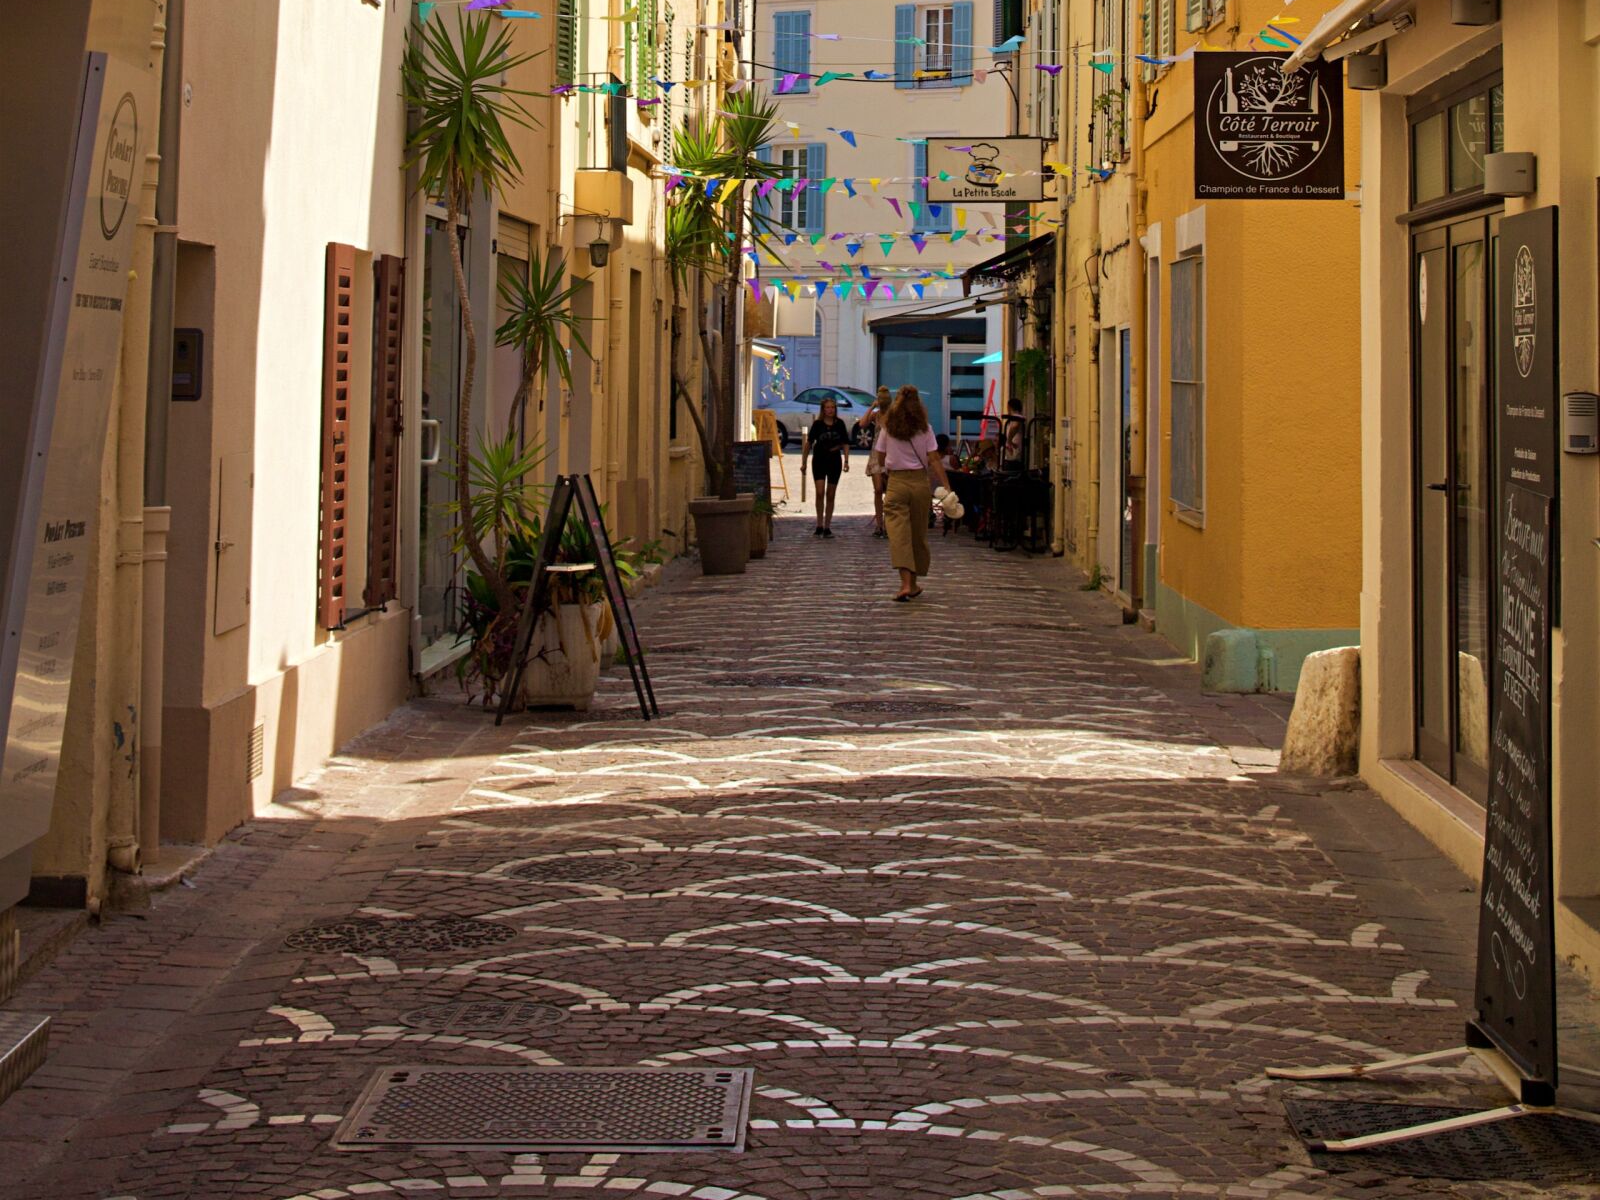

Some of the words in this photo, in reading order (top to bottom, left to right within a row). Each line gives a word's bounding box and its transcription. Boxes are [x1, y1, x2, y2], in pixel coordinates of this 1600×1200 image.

[1219, 115, 1256, 132] Côté
[1261, 115, 1320, 132] Terroir
[952, 188, 963, 197] La
[964, 187, 989, 197] Petite
[991, 187, 1017, 197] Escale
[1199, 184, 1244, 194] Champion
[1246, 184, 1257, 193] de
[1259, 185, 1290, 194] France
[1292, 185, 1303, 194] du
[1305, 185, 1340, 194] Dessert
[1502, 584, 1536, 658] WELCOME
[1503, 670, 1528, 717] STREET
[1516, 788, 1532, 819] rue
